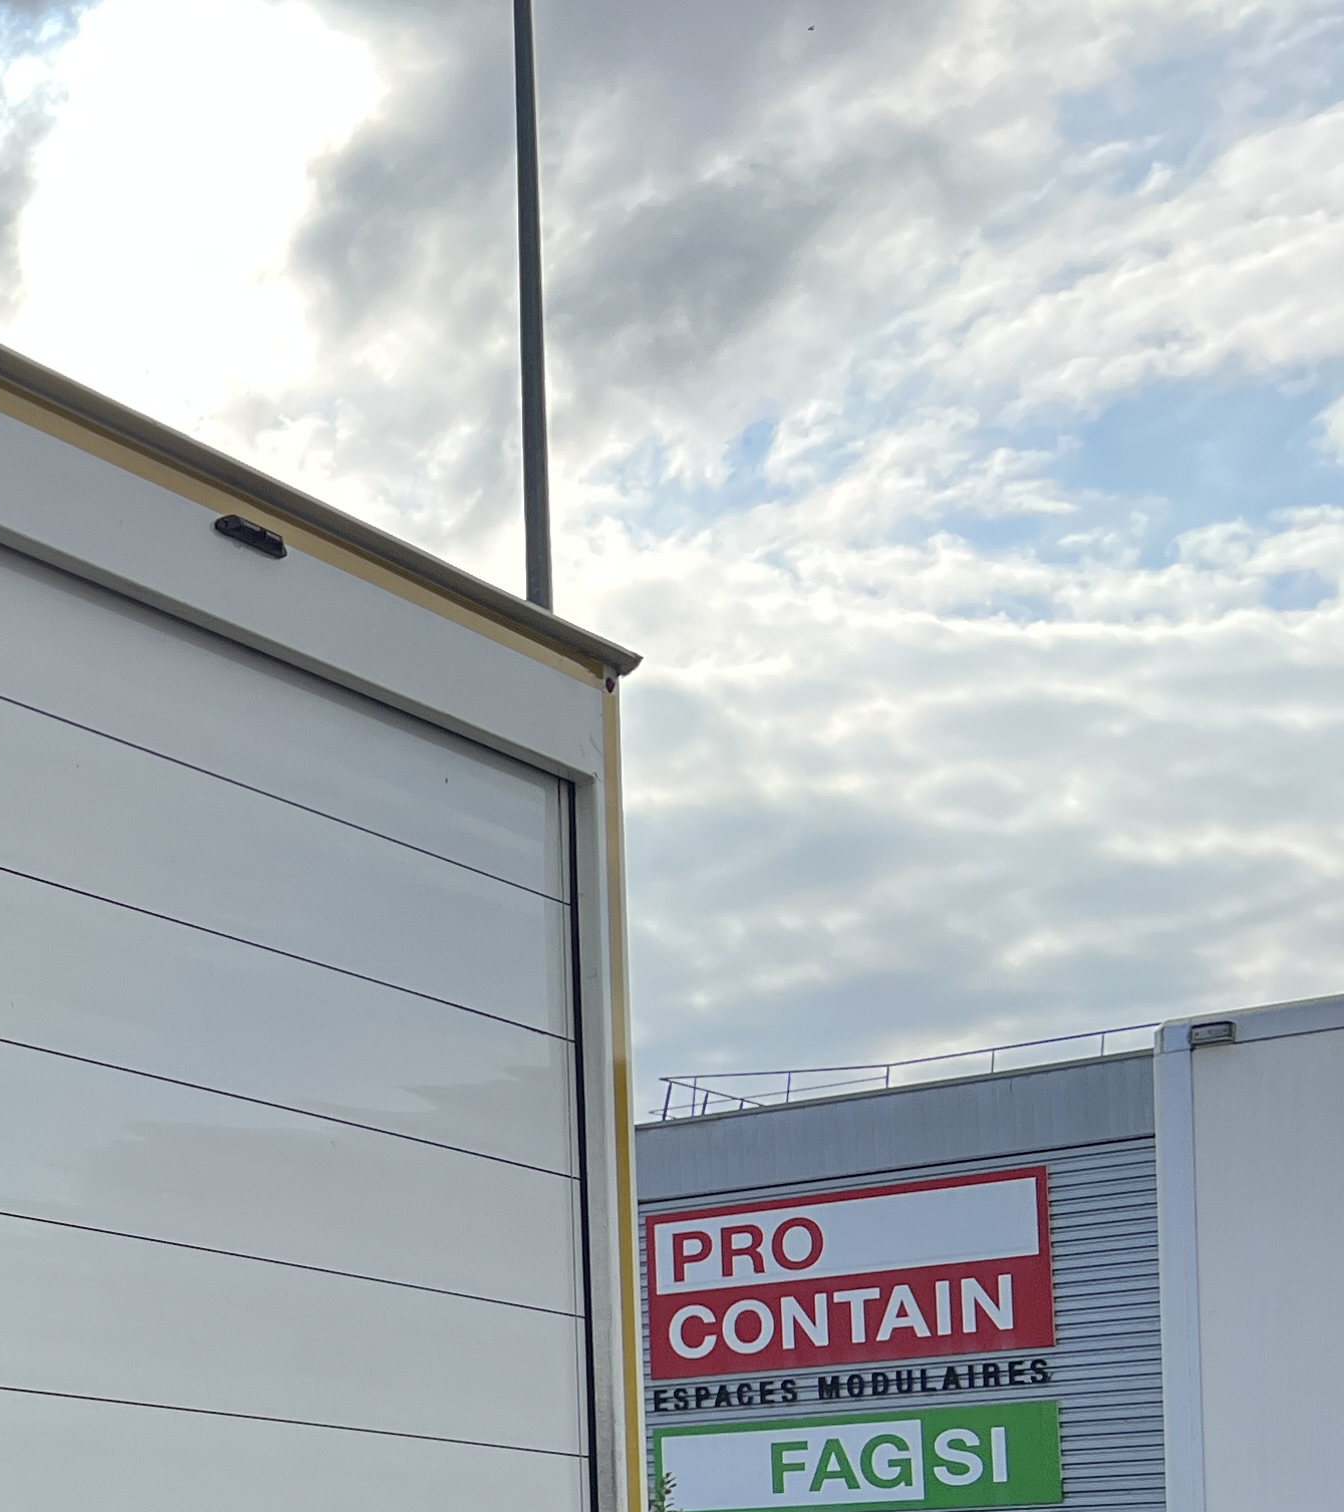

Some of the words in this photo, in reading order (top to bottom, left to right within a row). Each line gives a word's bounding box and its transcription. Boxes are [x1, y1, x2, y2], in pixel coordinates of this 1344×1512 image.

[672, 1216, 825, 1283] PRO
[668, 1274, 1015, 1360] CONTAIN
[654, 1379, 799, 1412] ESPACES
[818, 1358, 1052, 1400] MODULAIRES
[771, 1426, 1008, 1494] FAGSI
